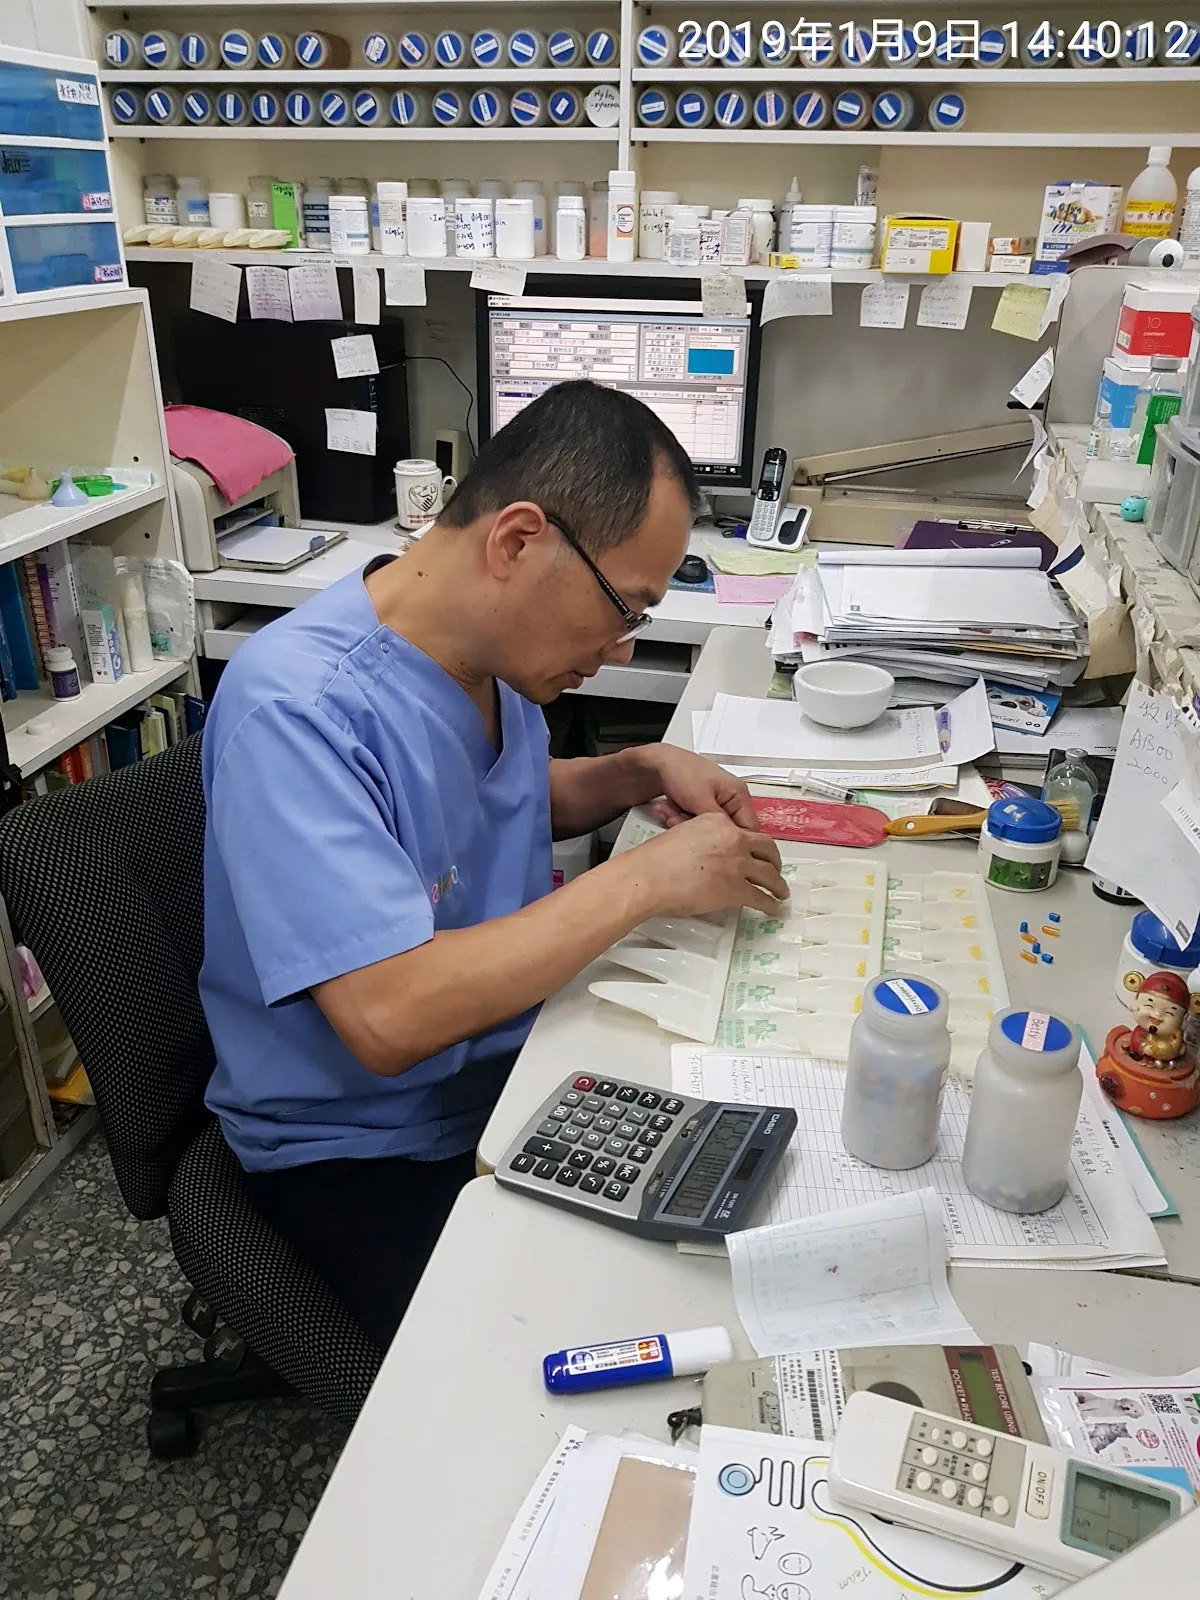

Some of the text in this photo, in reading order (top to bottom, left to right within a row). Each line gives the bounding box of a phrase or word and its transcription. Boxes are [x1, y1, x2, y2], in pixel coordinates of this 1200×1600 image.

[1029, 1018, 1046, 1040] Betty
[610, 1104, 620, 1112] 4
[579, 1113, 589, 1121] 2
[632, 1111, 642, 1119] 7
[599, 1118, 610, 1126] 5
[764, 1112, 780, 1135] CASIO
[566, 1127, 576, 1135] 3
[622, 1125, 632, 1133] 8
[588, 1134, 598, 1142] 6
[611, 1141, 621, 1149] 9
[622, 1165, 635, 1180] MC
[611, 1183, 622, 1197] GT
[950, 1367, 966, 1398] POCKET
[990, 1367, 1017, 1434] TEST BEFORE USING
[1037, 1471, 1047, 1505] ON/OFF
